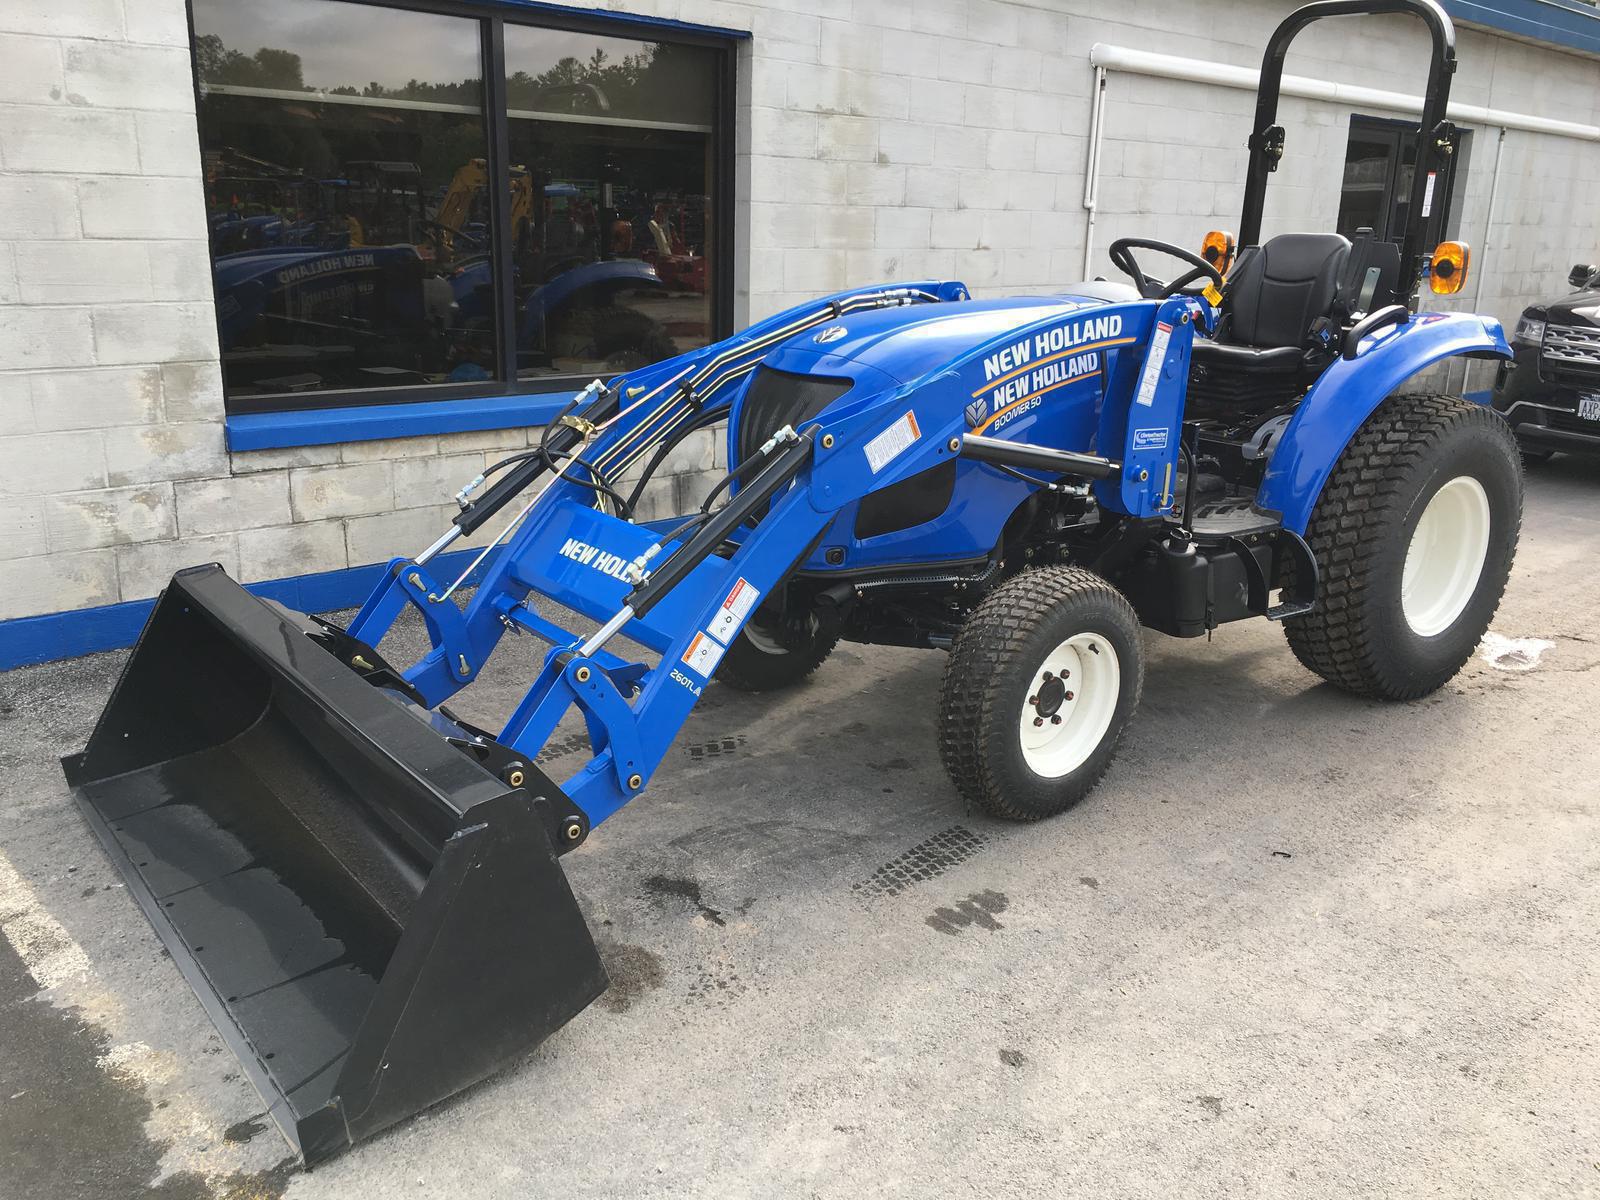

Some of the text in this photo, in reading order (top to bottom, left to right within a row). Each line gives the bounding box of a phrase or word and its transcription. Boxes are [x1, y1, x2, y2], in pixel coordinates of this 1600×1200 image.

[983, 315, 1122, 381] NEW HOLLAND
[993, 374, 1030, 412] NEW
[1032, 352, 1098, 391] HOLLAND
[994, 396, 1042, 431] BOOMER 50
[559, 537, 600, 565] NEW
[669, 668, 702, 697] 260TLA
